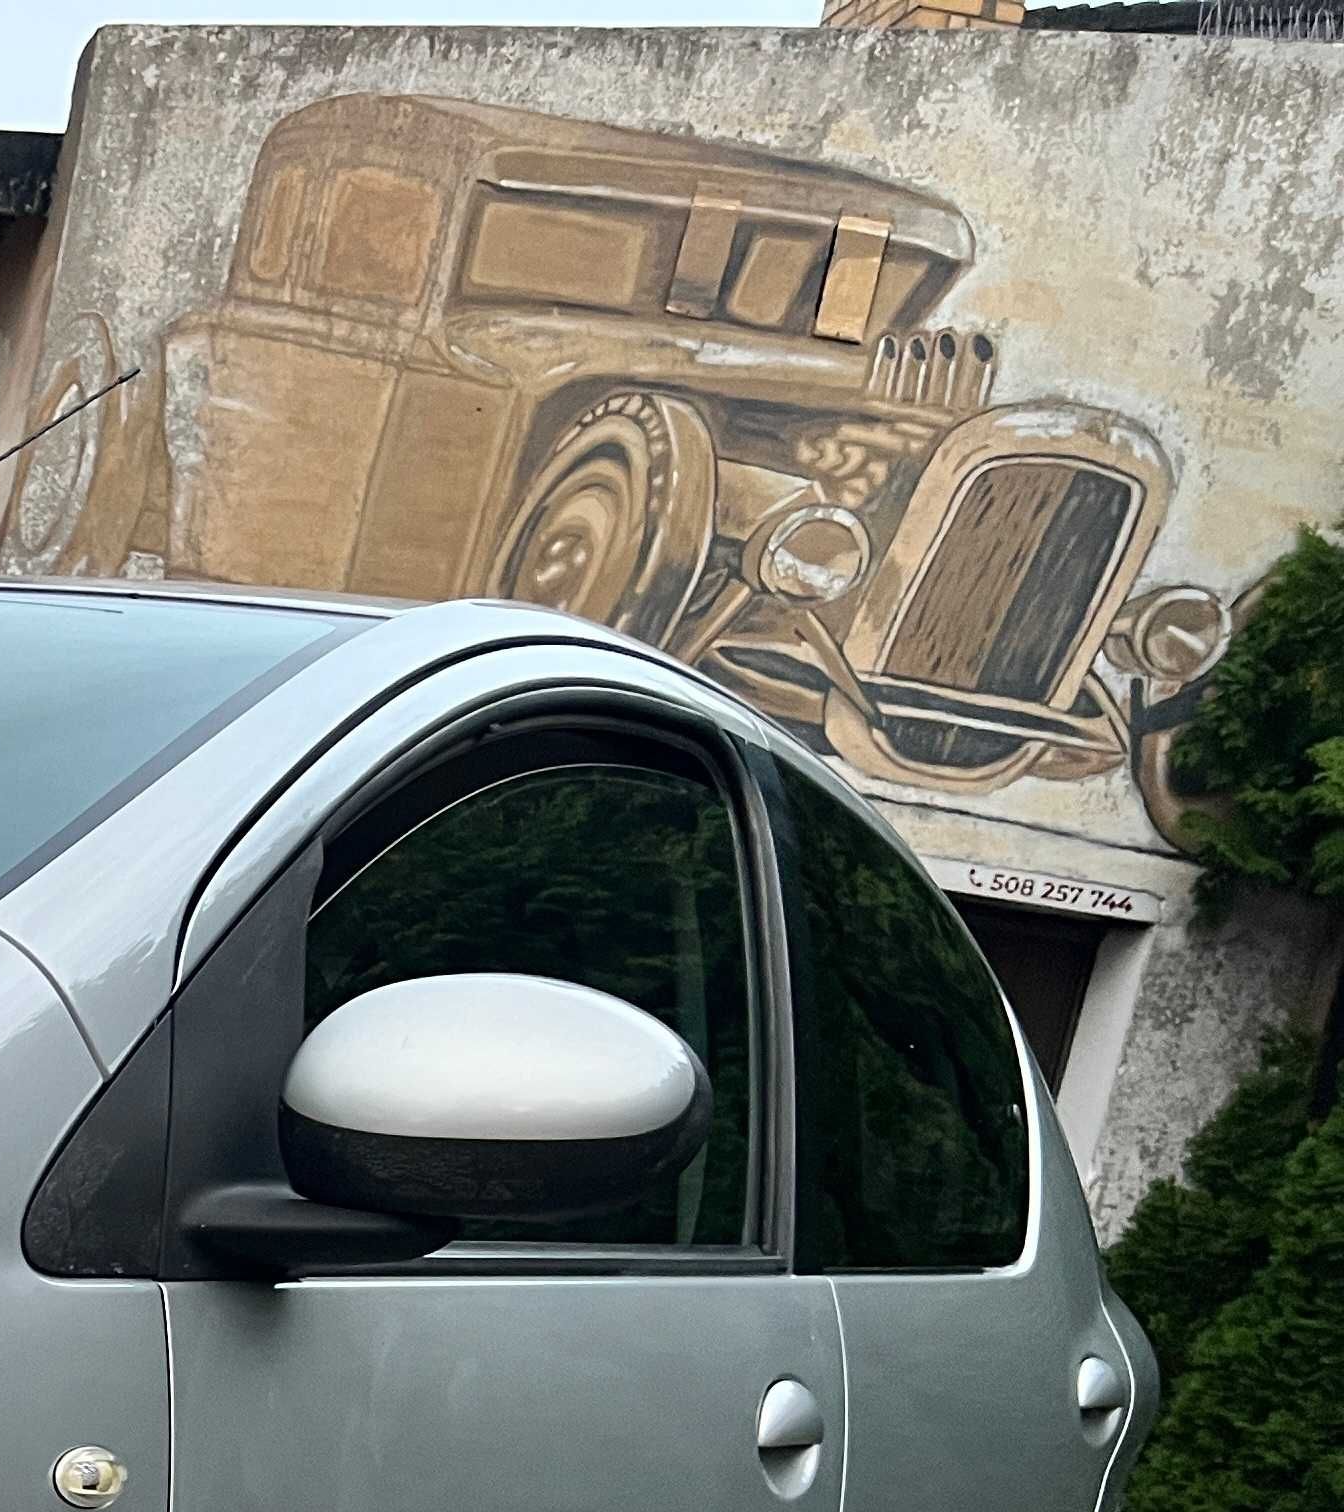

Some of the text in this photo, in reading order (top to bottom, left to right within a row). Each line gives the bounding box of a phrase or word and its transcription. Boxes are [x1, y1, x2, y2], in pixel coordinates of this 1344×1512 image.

[990, 873, 1133, 914] 508 257 744
